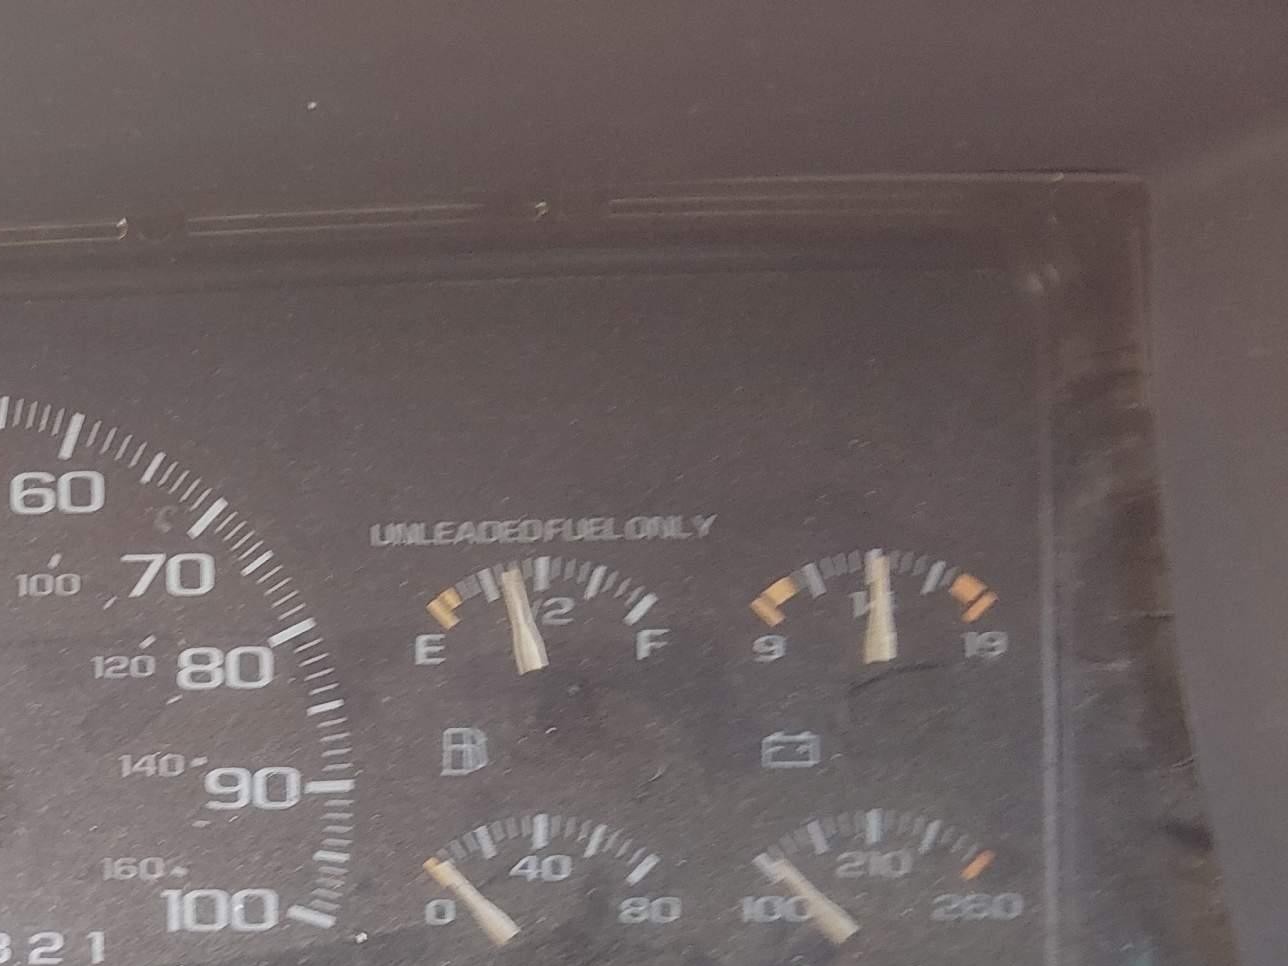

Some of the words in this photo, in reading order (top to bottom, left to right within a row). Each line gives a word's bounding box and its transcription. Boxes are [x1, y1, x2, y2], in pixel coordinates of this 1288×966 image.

[10, 471, 105, 514] 60
[370, 519, 544, 547] UNLEADED
[542, 517, 624, 542] FUEL
[624, 513, 718, 540] ONLY
[18, 574, 80, 596] 100
[122, 554, 214, 596] 70
[415, 633, 446, 666] E
[637, 628, 670, 661] F
[753, 634, 786, 662] 9
[93, 657, 155, 678] 120
[177, 647, 274, 690] 80
[120, 754, 184, 776] 140
[205, 766, 300, 811] 90
[105, 858, 166, 880] 160
[510, 855, 572, 881] 40
[160, 889, 278, 932] 100
[425, 899, 456, 925] 0
[619, 896, 681, 923] 80
[27, 931, 64, 965] 2
[86, 931, 105, 964] 1
